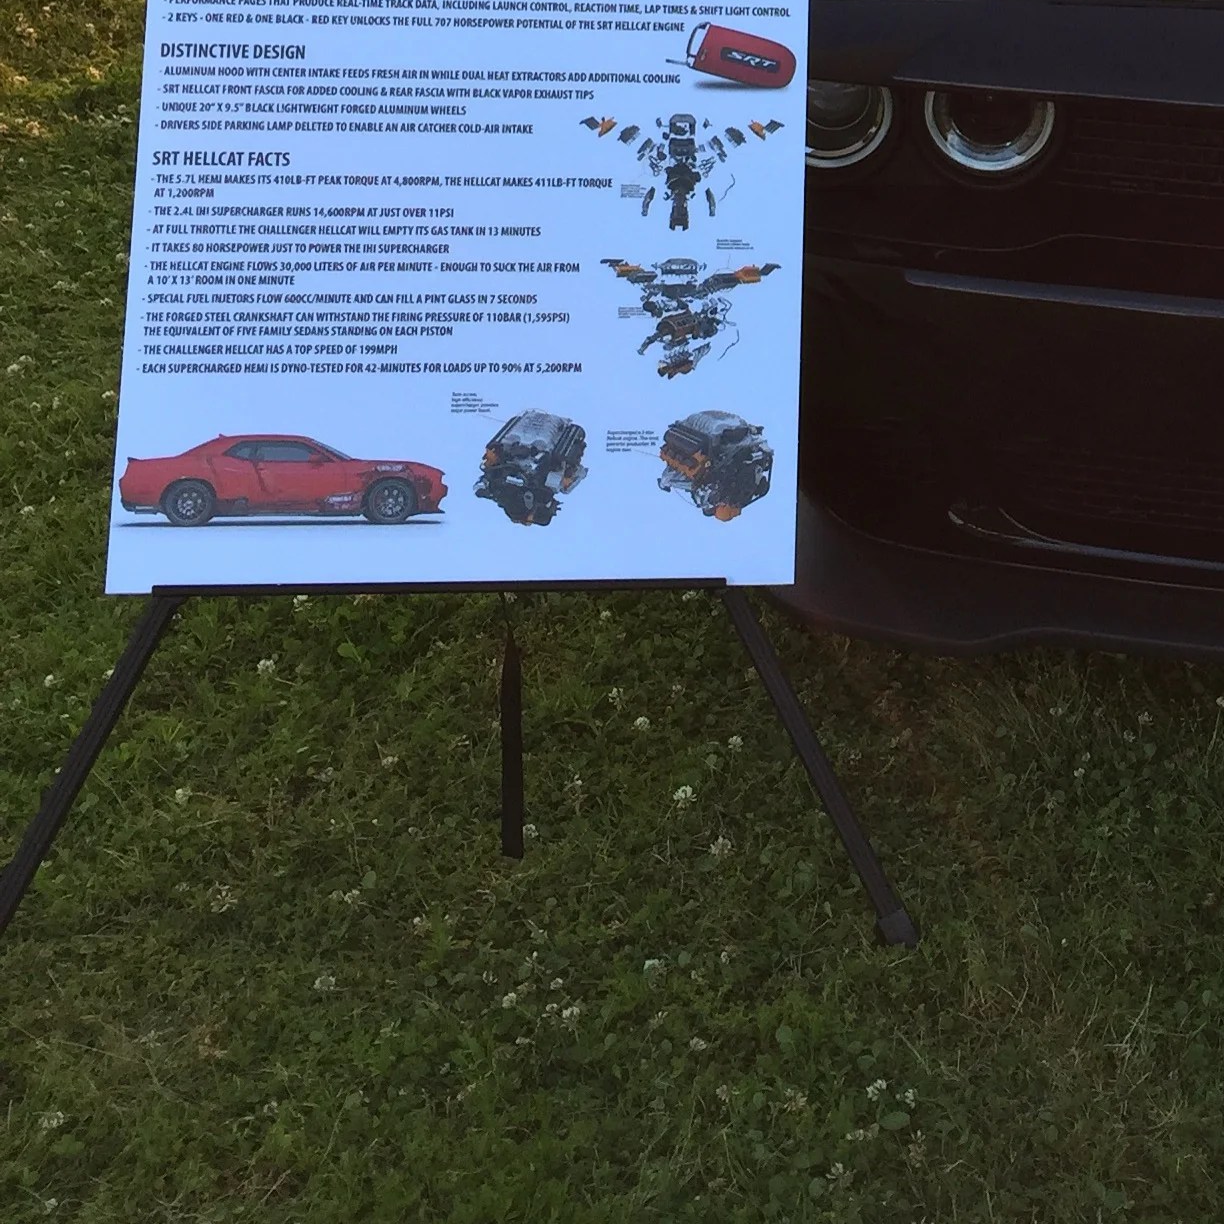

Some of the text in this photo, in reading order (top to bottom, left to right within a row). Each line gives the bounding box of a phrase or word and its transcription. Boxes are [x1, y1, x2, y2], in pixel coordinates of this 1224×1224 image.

[160, 42, 305, 60] DISTINCTIVE DESIGN
[727, 50, 777, 69] SRT
[161, 101, 197, 112] UNIQUE
[216, 102, 223, 112] X
[245, 102, 275, 113] BLACK
[275, 102, 339, 114] LIGHTWEIGHT
[340, 104, 377, 114] FORGED
[377, 104, 429, 115] ALUMINUM
[430, 105, 467, 115] WHEELS
[160, 119, 533, 134] DRIVERS SIDE PARKING LAMP DELETED TO ENABLE AN AIR CATCHER COLD-AIR INTAKE
[151, 150, 291, 167] SRT HELLCAT FACTS
[152, 224, 541, 237] AT FULL THROTTLE THE CHALLENGER HELLCAT WILL EMPTY ITS GAS TANK IN 13 MINUTES
[147, 275, 154, 285] A
[170, 274, 178, 285] X
[194, 275, 224, 285] ROOM
[224, 275, 236, 285] IN
[237, 275, 257, 285] ONE
[257, 274, 295, 285] MINUTE
[145, 311, 164, 322] THE
[165, 311, 203, 322] FORGED
[204, 311, 231, 322] STEEL
[232, 311, 294, 322] CRANKSHAFT
[295, 312, 314, 322] CAN
[315, 311, 371, 322] WITHSTAND
[371, 311, 389, 322] THE
[391, 311, 423, 322] FIRING
[424, 312, 471, 322] PRESSURE
[472, 311, 484, 322] OF
[486, 311, 522, 322] 110BAR
[142, 325, 453, 337] THE EQUIVALENT OF FIVE FAMILY SEDANS STANDING ON EACH PISTON
[142, 344, 397, 355] THE CHALLENGER HELLCAT HAS A TOP SPEED OF 199MPH
[141, 363, 166, 373] EACH
[167, 363, 242, 373] SUPERCHARGED
[243, 362, 269, 373] HEMI
[269, 362, 280, 373] IS
[280, 362, 344, 373] DYNO-TESTED
[344, 362, 364, 373] FOR
[364, 362, 422, 373] 42-MINUTES
[422, 362, 442, 373] FOR
[442, 362, 472, 373] LOADS
[473, 362, 487, 373] UP
[488, 362, 500, 372] TO
[522, 362, 535, 372] AT
